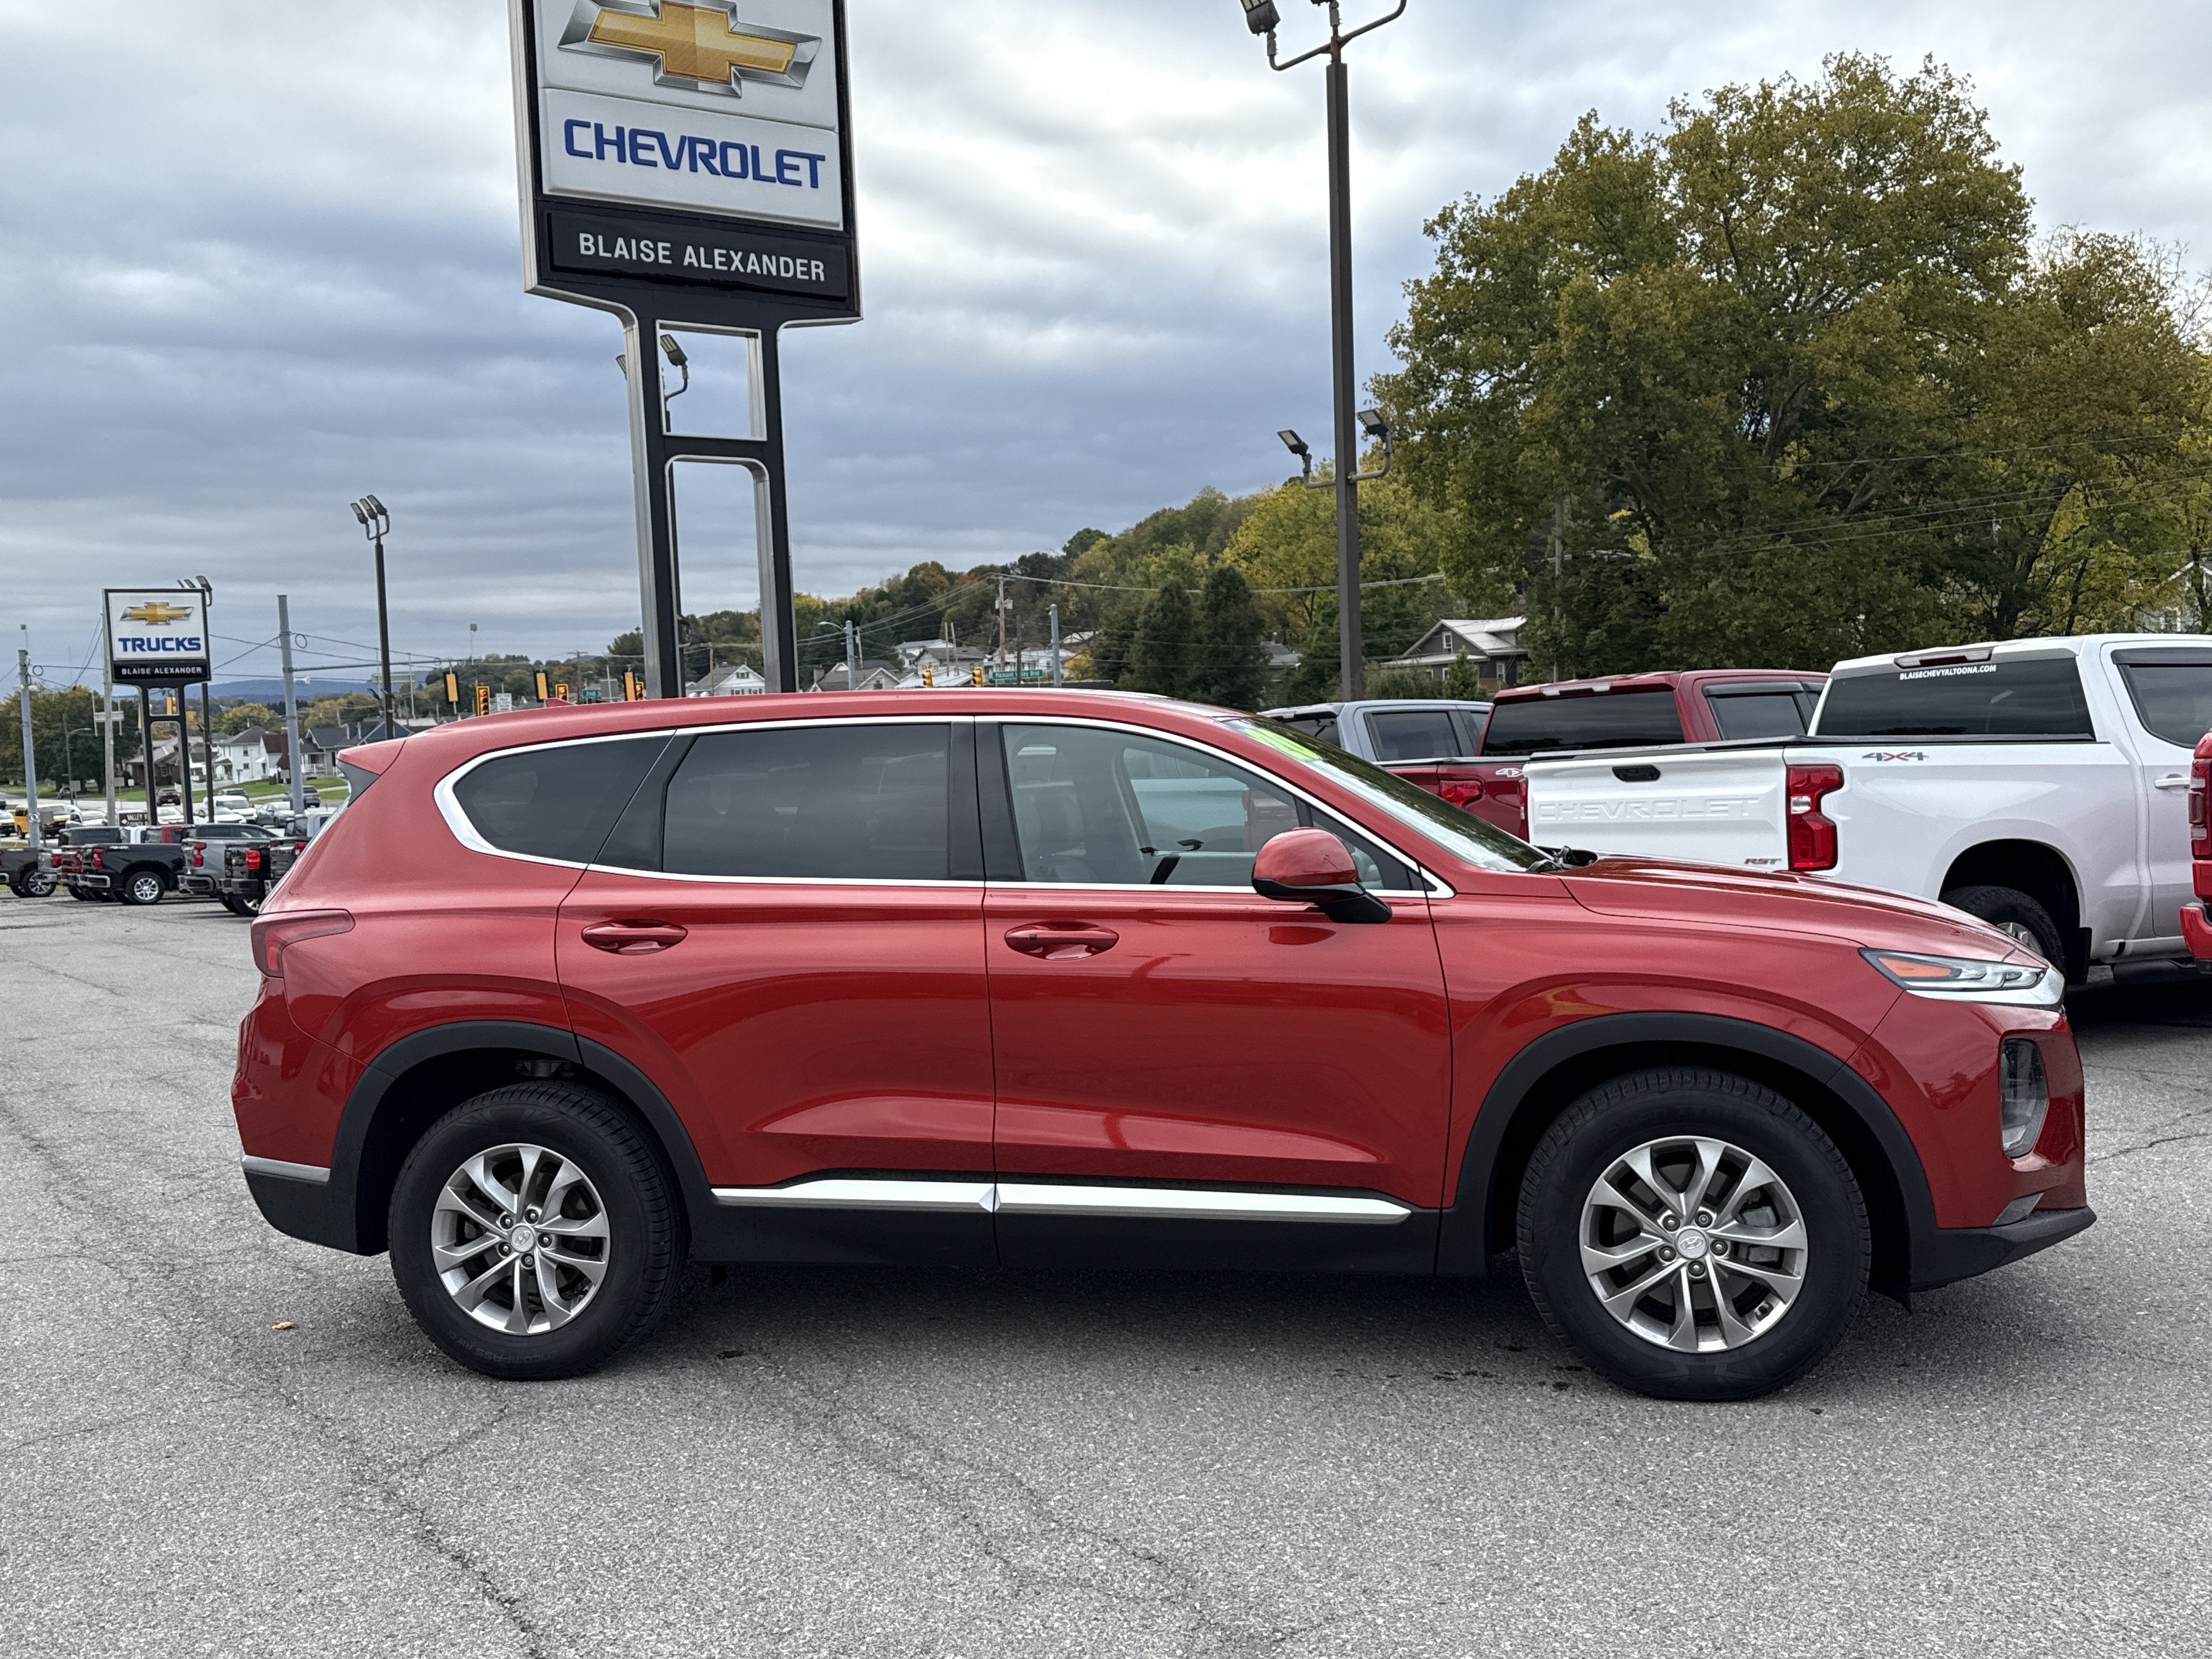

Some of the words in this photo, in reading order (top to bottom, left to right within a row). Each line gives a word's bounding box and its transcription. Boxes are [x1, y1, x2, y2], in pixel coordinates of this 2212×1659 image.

[564, 119, 826, 189] CHEVROLET
[579, 233, 672, 264] BLAISE
[683, 245, 825, 281] ALEXANDER
[118, 637, 201, 652] TRUCKS
[121, 667, 151, 675] BLAISE
[1899, 664, 1997, 680] BLAISECHEVYALTOONA.COM
[1861, 752, 1930, 761] 4X4
[1538, 797, 1759, 820] CHEVROLET
